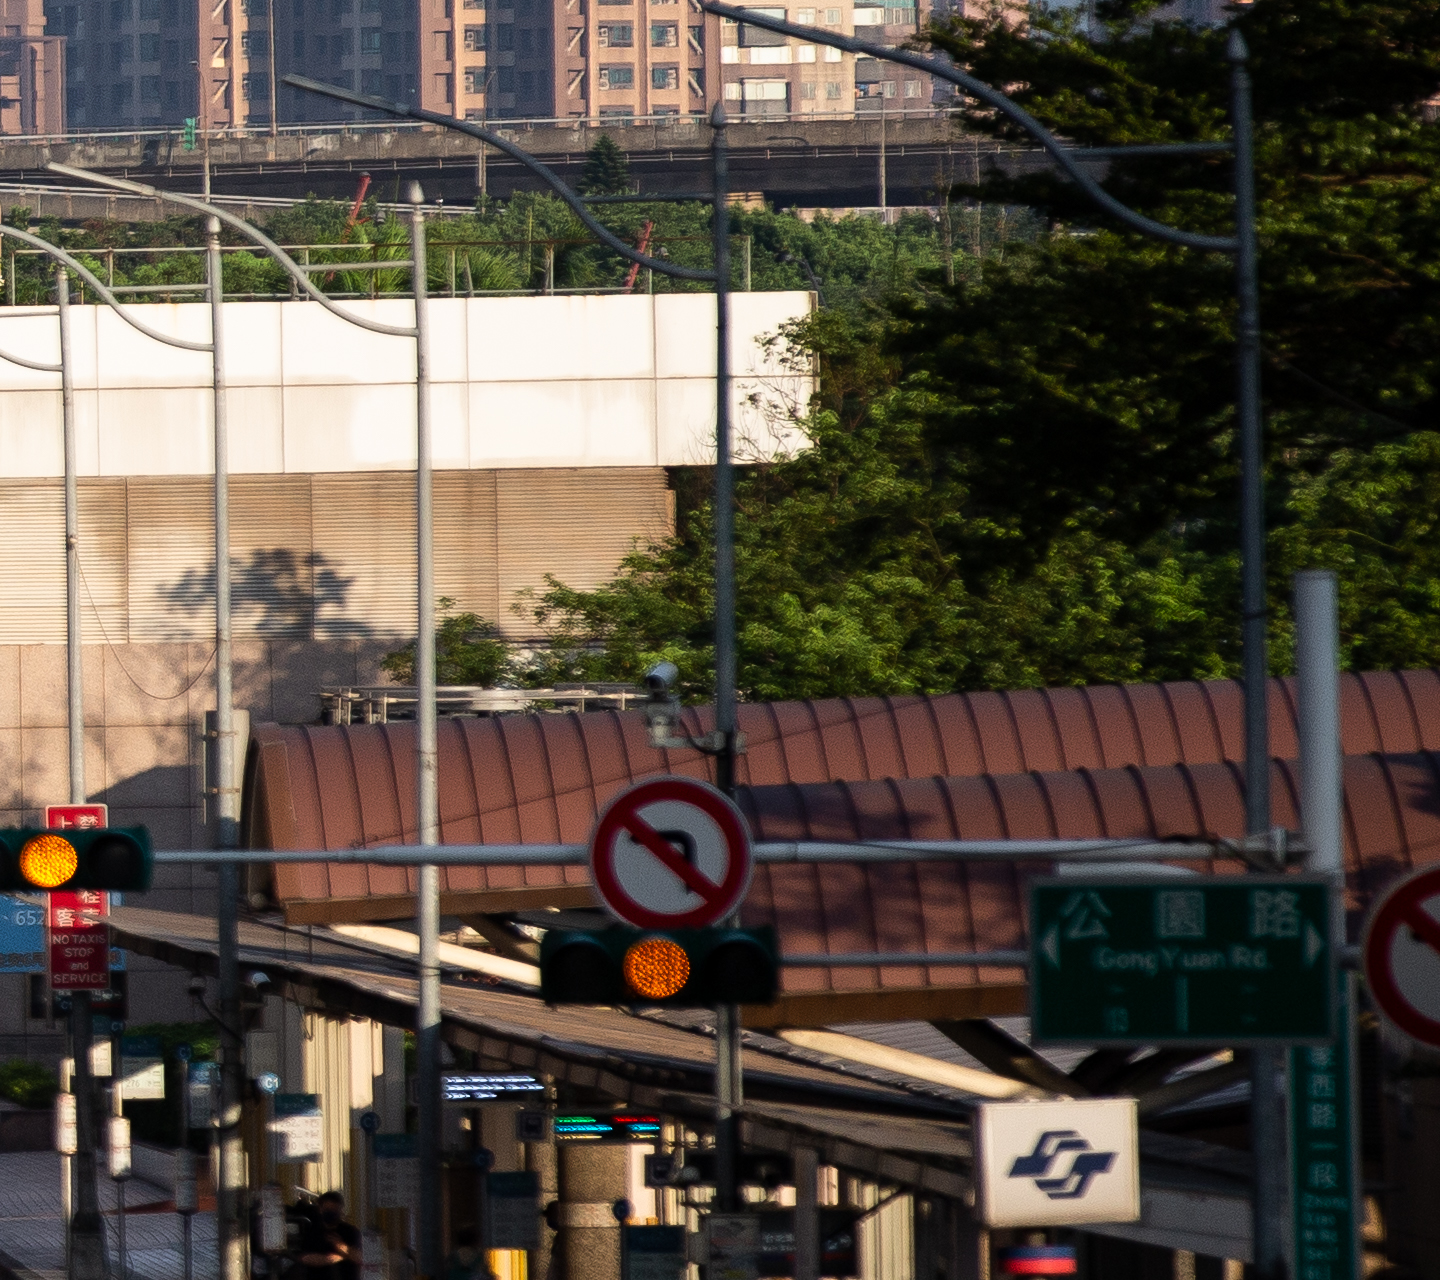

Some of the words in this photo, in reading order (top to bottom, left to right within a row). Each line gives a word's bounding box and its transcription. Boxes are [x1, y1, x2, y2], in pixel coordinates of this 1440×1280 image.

[1058, 889, 1300, 939] 公園路
[52, 935, 70, 945] NO
[73, 934, 106, 944] TAXIS
[64, 947, 94, 957] STOP
[53, 973, 107, 984] SERVICE
